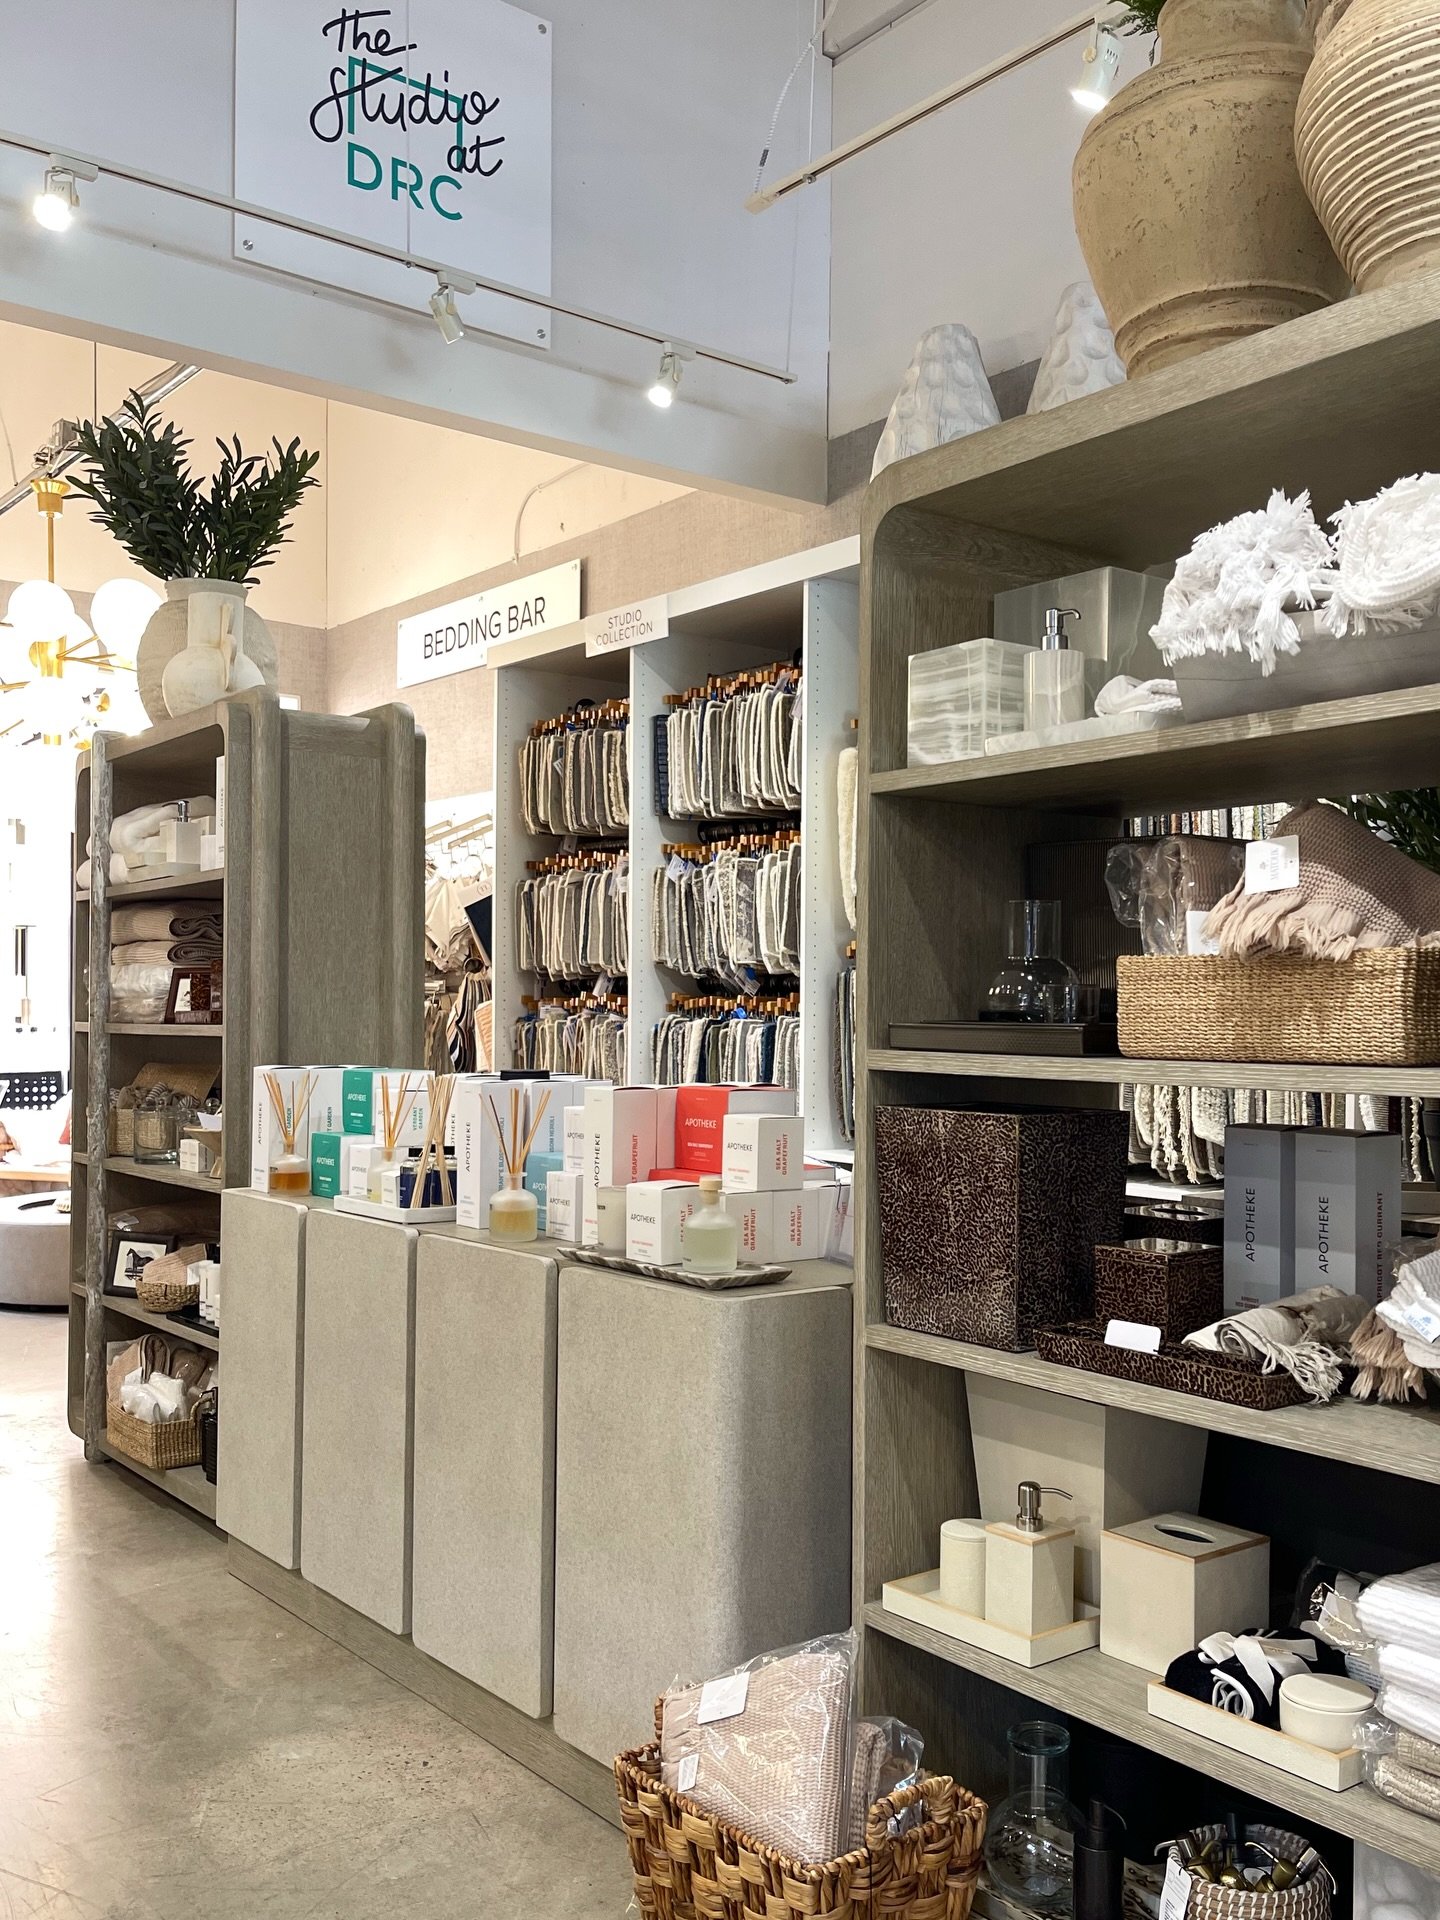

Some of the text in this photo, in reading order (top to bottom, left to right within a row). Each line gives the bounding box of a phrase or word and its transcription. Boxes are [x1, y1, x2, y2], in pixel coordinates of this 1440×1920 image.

[322, 8, 417, 56] The
[447, 135, 505, 177] at
[347, 141, 463, 221] DRC
[423, 596, 546, 660] BEDDING BAR
[595, 621, 654, 647] COLLECTION
[607, 609, 642, 630] STUDIO
[567, 1131, 585, 1140] APOTHE
[685, 1117, 717, 1130] APOTHEKE
[727, 1142, 753, 1152] APOTHEKE
[630, 1213, 656, 1225] APOTHEKE
[1245, 1187, 1256, 1262] APOTHEKE
[1318, 1196, 1329, 1274] APOTHEKE
